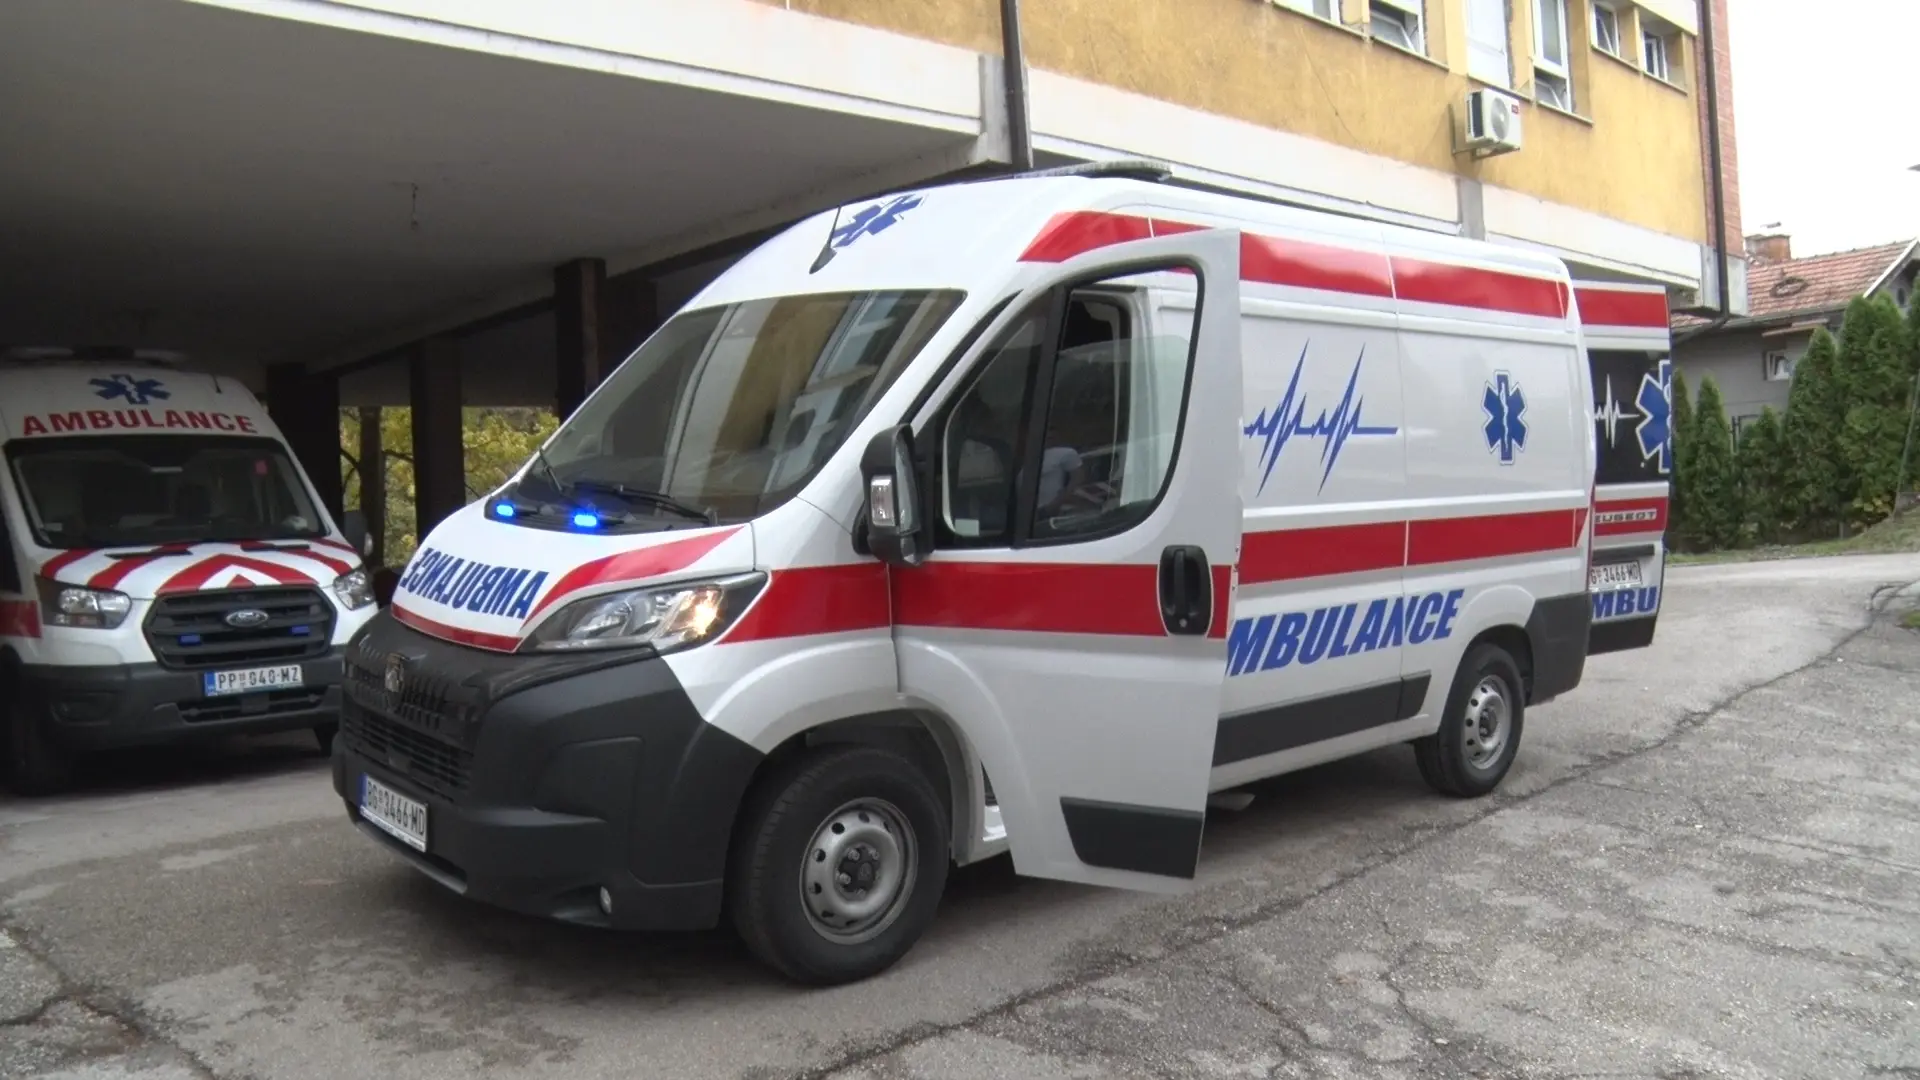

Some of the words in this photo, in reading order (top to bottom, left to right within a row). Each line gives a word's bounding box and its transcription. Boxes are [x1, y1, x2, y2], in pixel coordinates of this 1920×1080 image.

[22, 409, 258, 436] AMBULANCE
[1591, 586, 1657, 618] MBU
[1225, 588, 1465, 677] MBULANCE
[218, 672, 237, 688] PP
